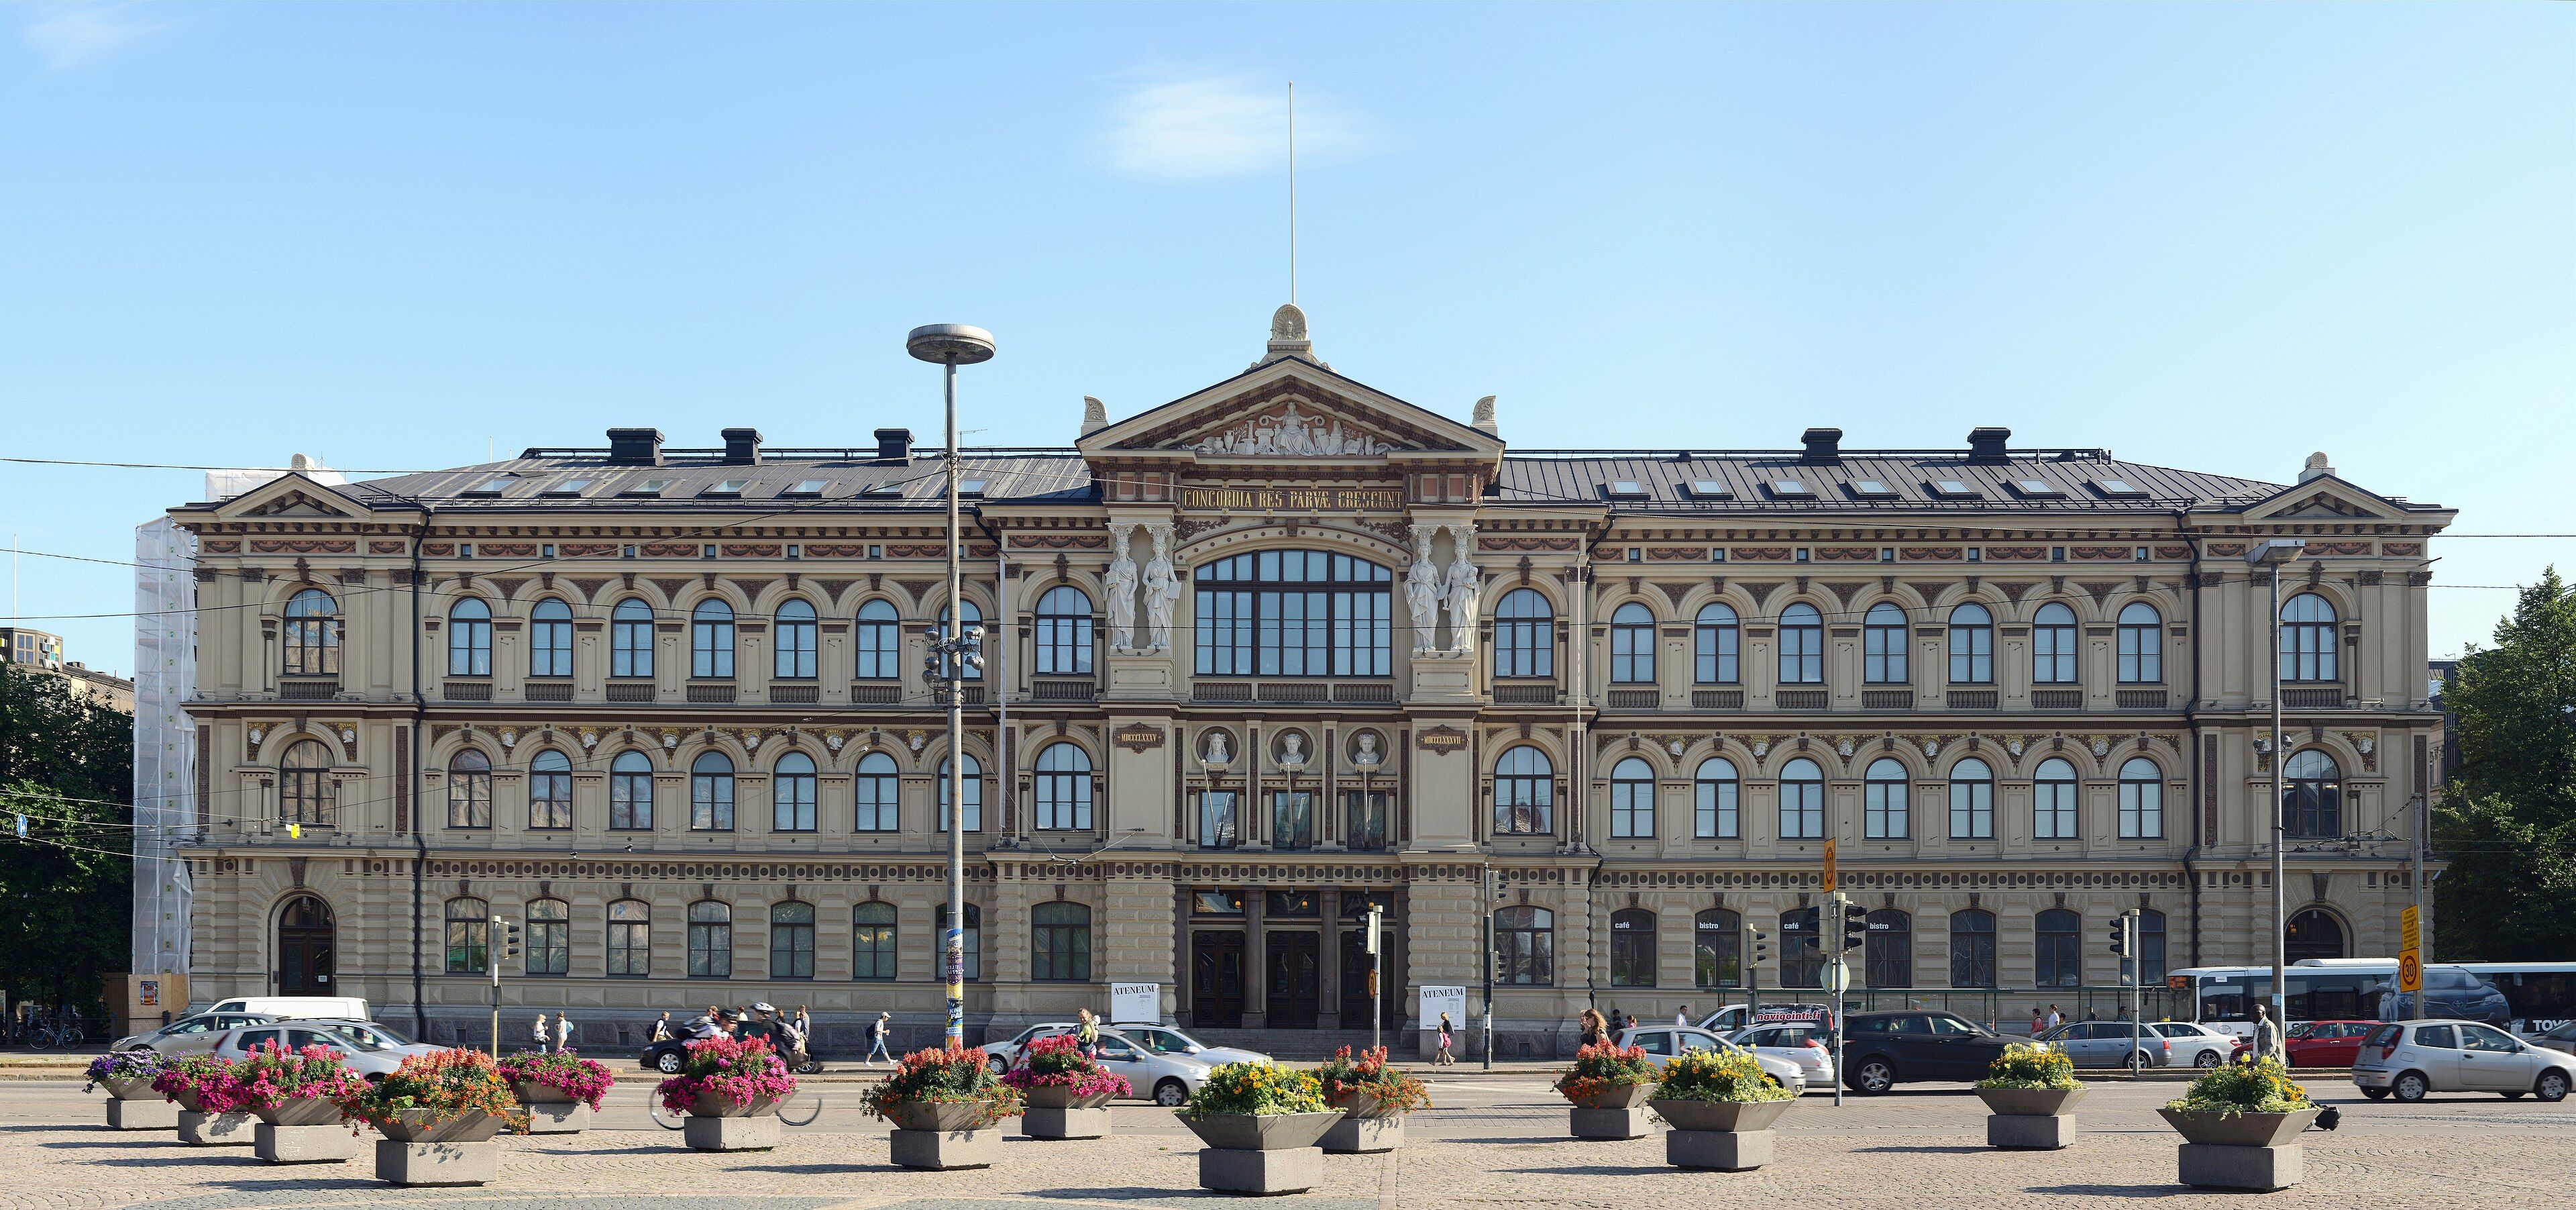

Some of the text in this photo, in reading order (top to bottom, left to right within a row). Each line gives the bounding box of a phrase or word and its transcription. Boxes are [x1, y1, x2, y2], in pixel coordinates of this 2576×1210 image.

[1185, 490, 1252, 507] CONCORDIA
[1258, 491, 1283, 508] RES
[1338, 491, 1402, 508] CRESCUNT
[2405, 963, 2414, 978] 30
[1114, 985, 1155, 995] ATENEUM
[1422, 988, 1463, 999] ATENEUM
[1757, 1011, 1821, 1021] navigointi.fi
[2532, 1019, 2571, 1031] TOY
